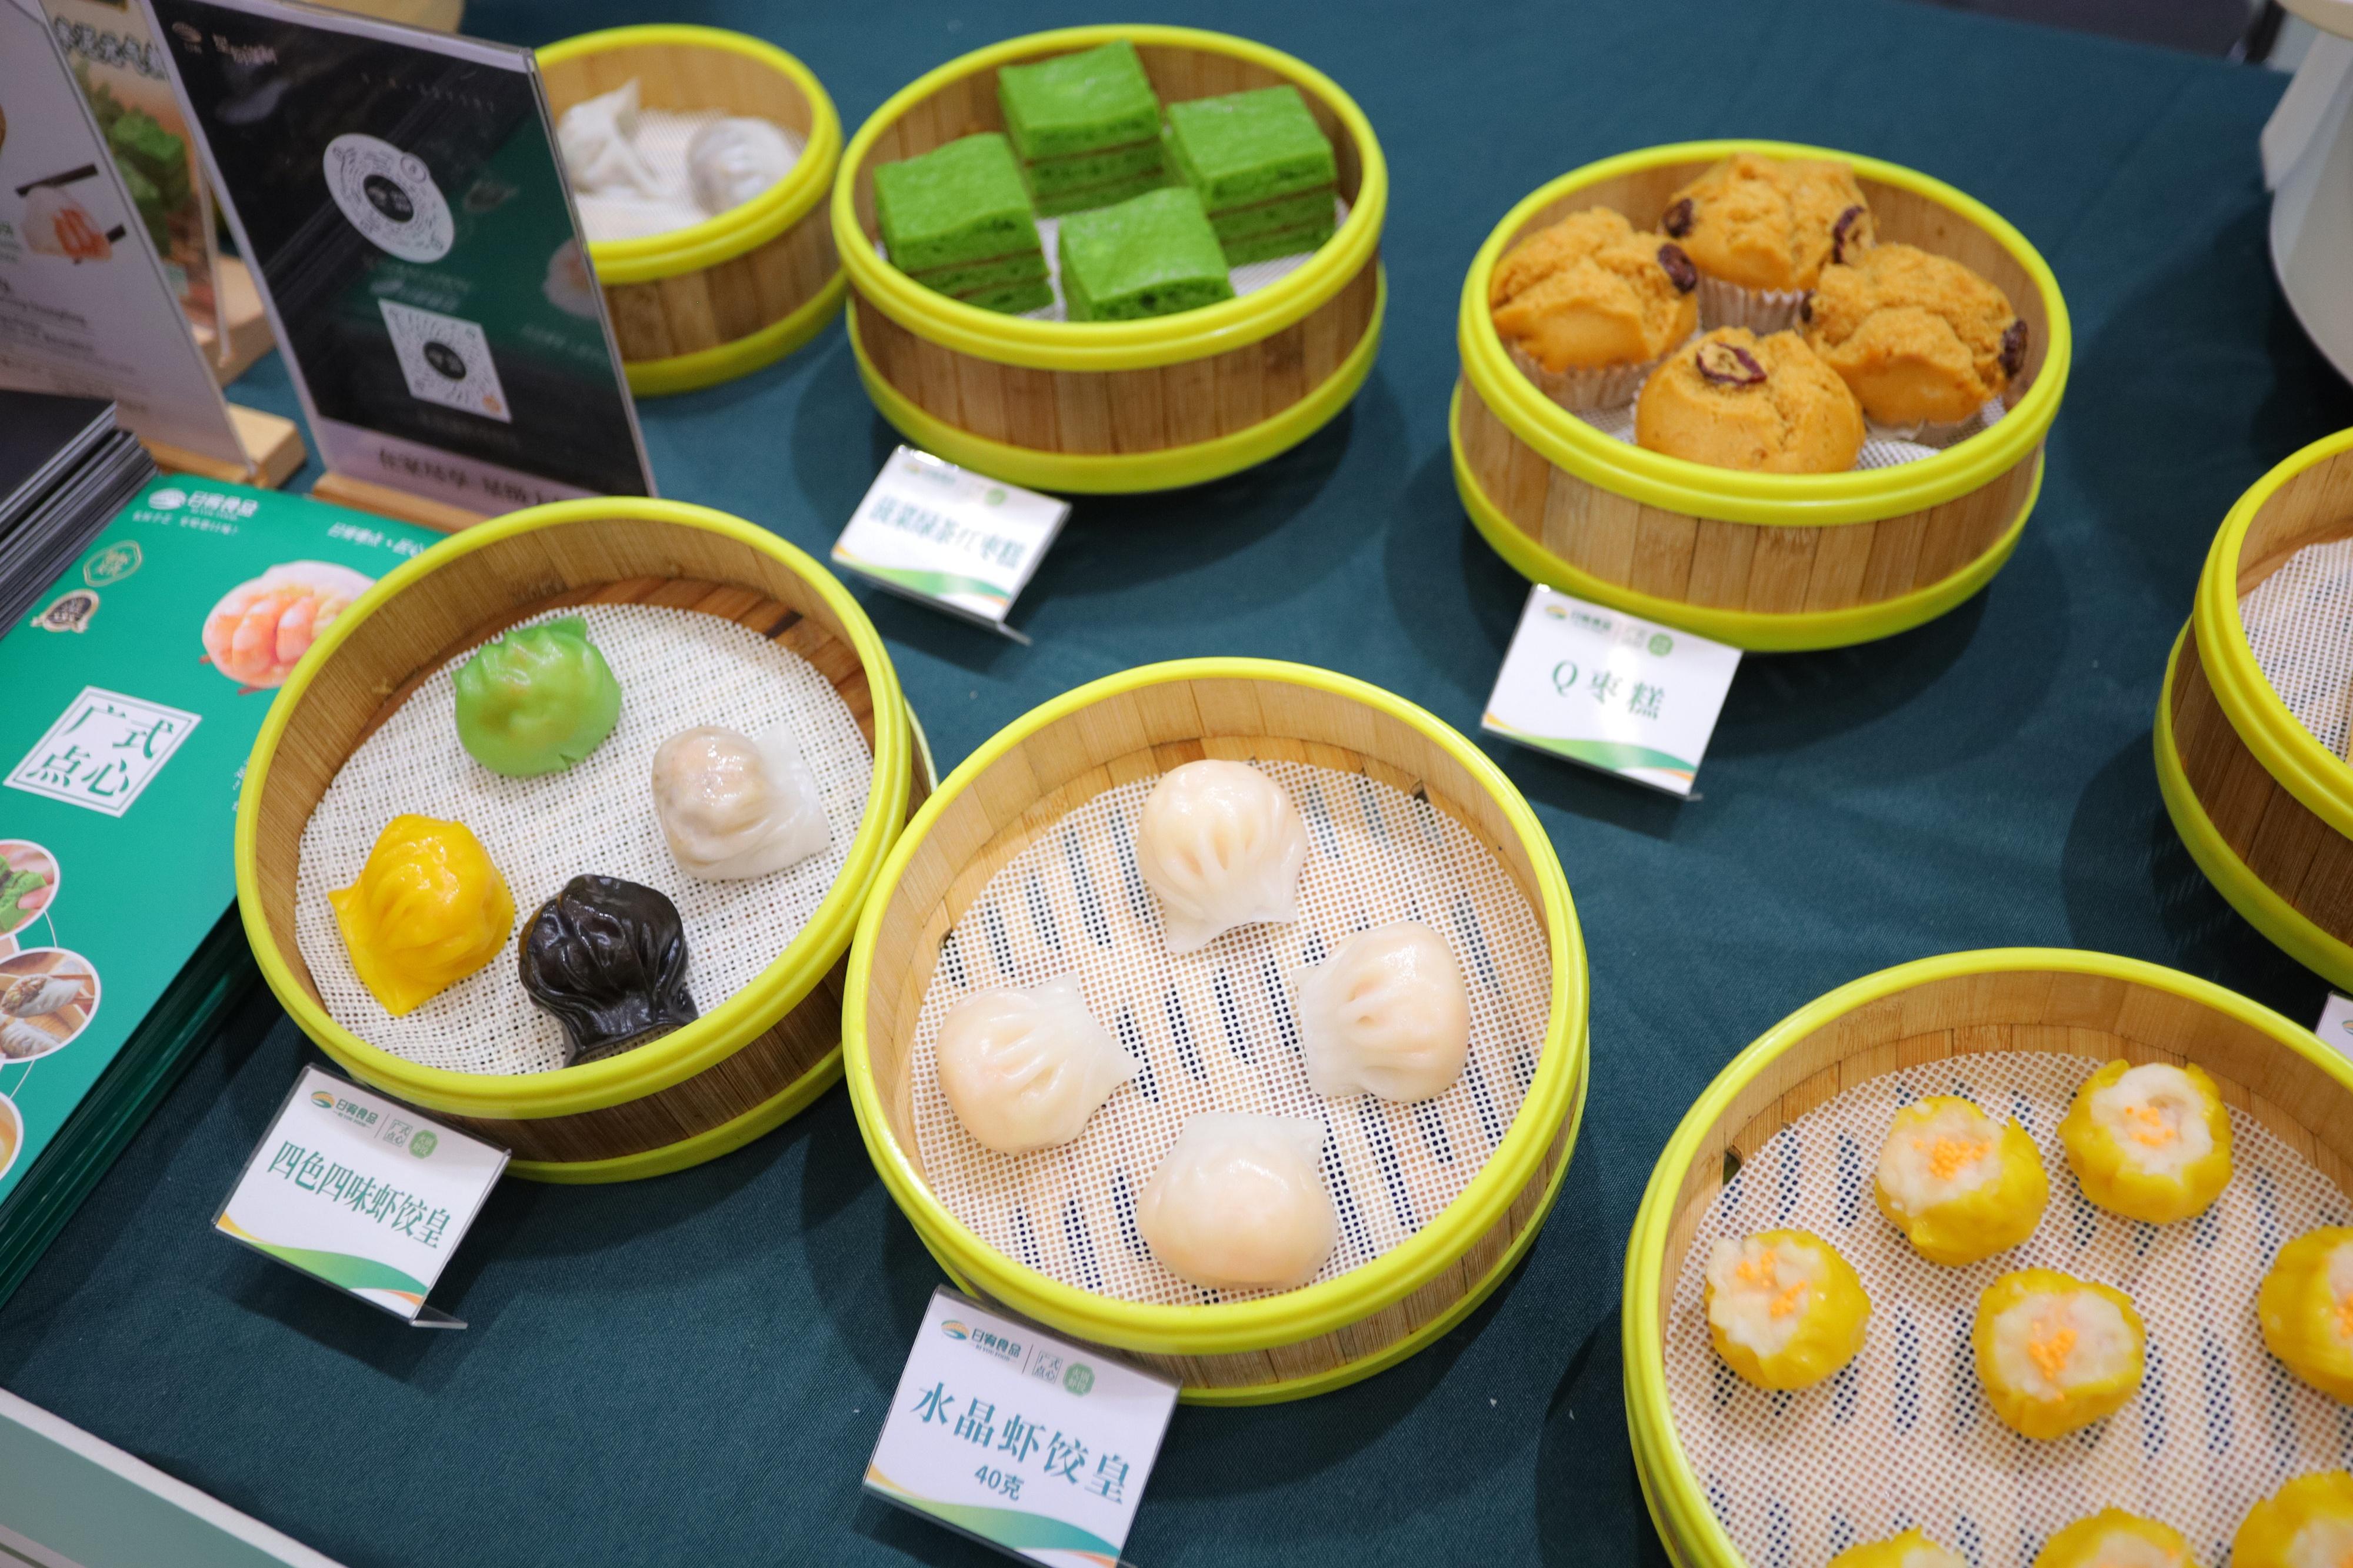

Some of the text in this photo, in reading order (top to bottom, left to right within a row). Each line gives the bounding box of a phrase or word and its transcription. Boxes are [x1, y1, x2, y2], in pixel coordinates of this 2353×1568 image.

[61, 705, 176, 759] 广式
[26, 743, 129, 796] 点心
[268, 1140, 451, 1249] 四色四味虾饺皇
[909, 1381, 1130, 1505] 水晶虾饺皇
[974, 1464, 1025, 1502] 40克
